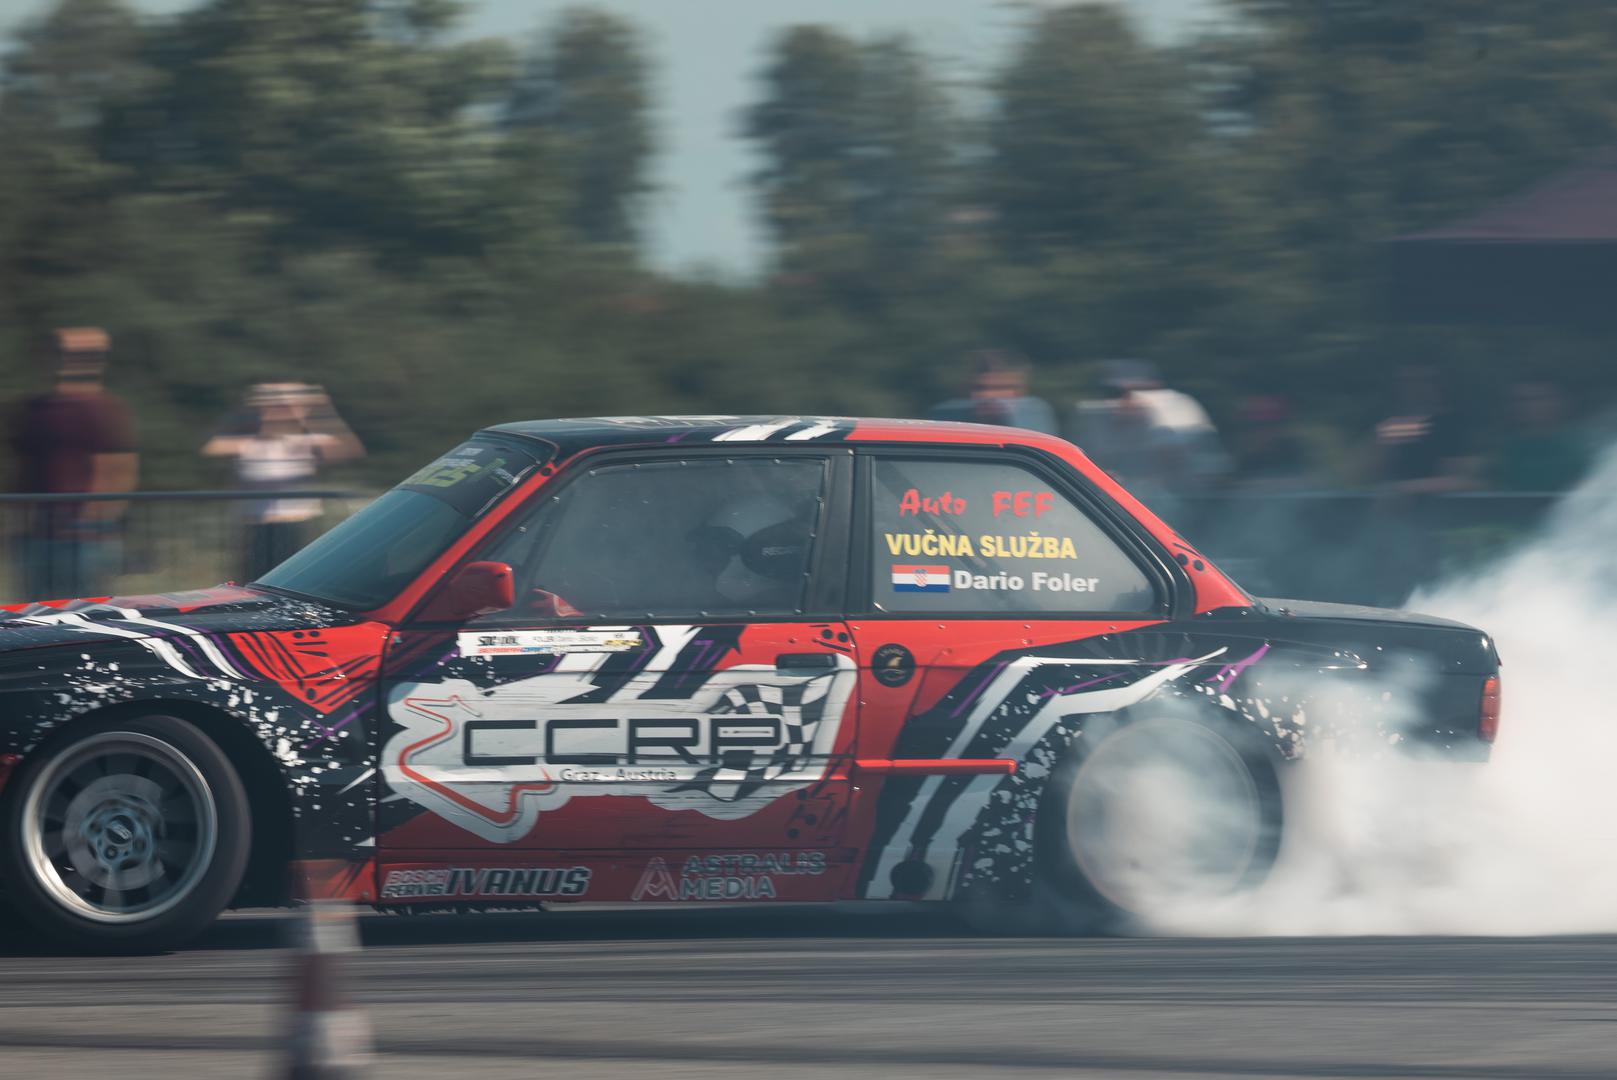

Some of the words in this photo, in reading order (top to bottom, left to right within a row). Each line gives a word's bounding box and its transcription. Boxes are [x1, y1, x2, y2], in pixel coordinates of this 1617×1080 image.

[899, 489, 967, 517] Auto
[992, 491, 1055, 518] FEF
[885, 529, 974, 557] VUČNA
[979, 532, 1077, 560] SLUŽBA
[954, 570, 1024, 591] Dario
[1032, 571, 1099, 592] Foler
[463, 717, 781, 766] CCRP
[560, 767, 599, 782] Graz
[616, 766, 678, 782] Austria
[682, 852, 827, 876] ASTRALIS
[679, 876, 777, 900] MEDIA
